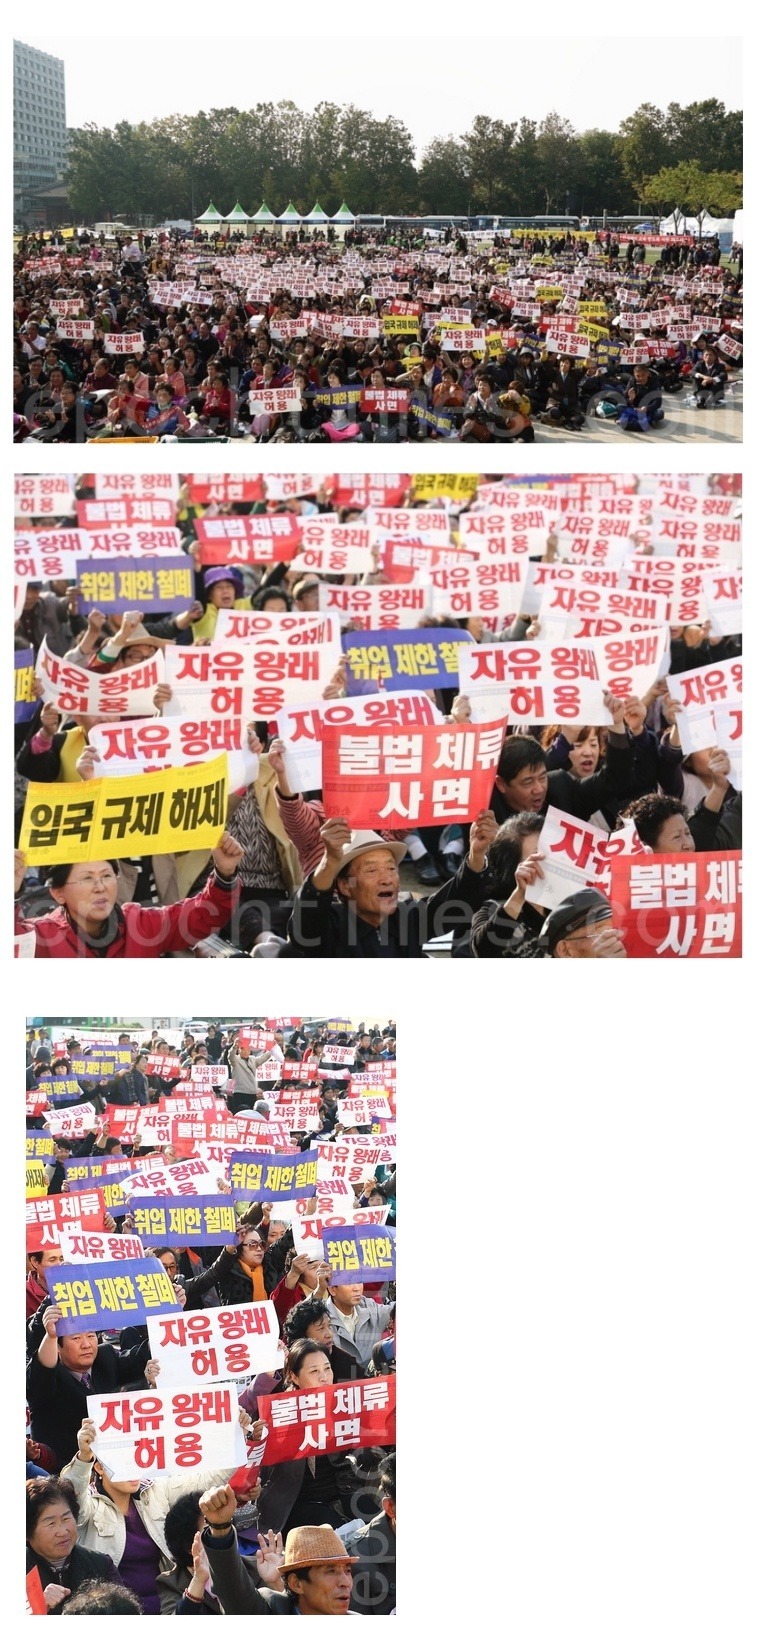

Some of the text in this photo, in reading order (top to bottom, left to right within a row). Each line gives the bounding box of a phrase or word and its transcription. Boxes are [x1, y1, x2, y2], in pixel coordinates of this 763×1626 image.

[107, 335, 123, 343] 자유
[444, 330, 483, 339] 자유 왕래
[549, 332, 589, 346] 자유 왕래
[253, 389, 297, 400] 자유 왕래
[264, 401, 288, 411] 허용
[387, 390, 408, 399] 체류
[103, 474, 172, 489] 자유 왕래
[130, 501, 172, 520] 체류
[598, 500, 633, 514] 자유
[660, 492, 733, 517] 자유 왕래
[203, 517, 293, 538] 불법 체류
[375, 513, 447, 530] 자유 왕래
[466, 511, 545, 534] 자유 왕래
[562, 516, 630, 537] 자유 왕래
[660, 520, 698, 539] 자유
[704, 522, 741, 542] 왕래
[37, 533, 82, 554] 왕래
[90, 532, 179, 552] 자유 왕래
[331, 528, 370, 548] 왕래
[15, 557, 63, 576] 허용
[430, 562, 520, 589] 자유 왕래
[80, 569, 192, 601] 취업 제한 철폐
[327, 589, 424, 611] 자유 왕래
[550, 587, 600, 612] 자유
[176, 651, 319, 681] 자유 왕래
[347, 642, 439, 680] 취업 제한
[471, 647, 599, 681] 자유 왕래
[604, 636, 658, 671] 왕래
[42, 651, 157, 695] 자유 왕래
[211, 687, 284, 715] 허용
[680, 669, 728, 708] 자유
[58, 691, 129, 713] 허용
[510, 685, 581, 718] 허용
[102, 718, 242, 761] 자유 왕래
[339, 727, 504, 775] 불법 체류
[378, 777, 471, 820] 사면
[28, 778, 226, 847] 입국 규제 해제
[629, 863, 697, 909] 불법
[656, 912, 737, 956] 사면
[114, 1108, 138, 1122] 불법
[342, 1100, 365, 1112] 자유
[144, 1115, 170, 1128] 자유
[178, 1122, 238, 1139] 불법 체류
[318, 1145, 380, 1165] 자유 왕래
[127, 1160, 209, 1190] 자유 왕래
[231, 1162, 263, 1190] 취업
[264, 1165, 295, 1191] 제한
[60, 1193, 100, 1219] 체류
[134, 1206, 236, 1235] 취업 제한 철폐
[69, 1235, 144, 1260] 자유 왕래
[328, 1237, 393, 1271] 취업 제한
[53, 1272, 177, 1317] 취업 제한 철폐
[159, 1307, 270, 1348] 자유 왕래
[191, 1344, 251, 1377] 허용
[99, 1390, 232, 1433] 자유 왕래
[271, 1381, 389, 1428] 불법 체류
[299, 1417, 361, 1451] 사면
[134, 1432, 203, 1470] 허용
